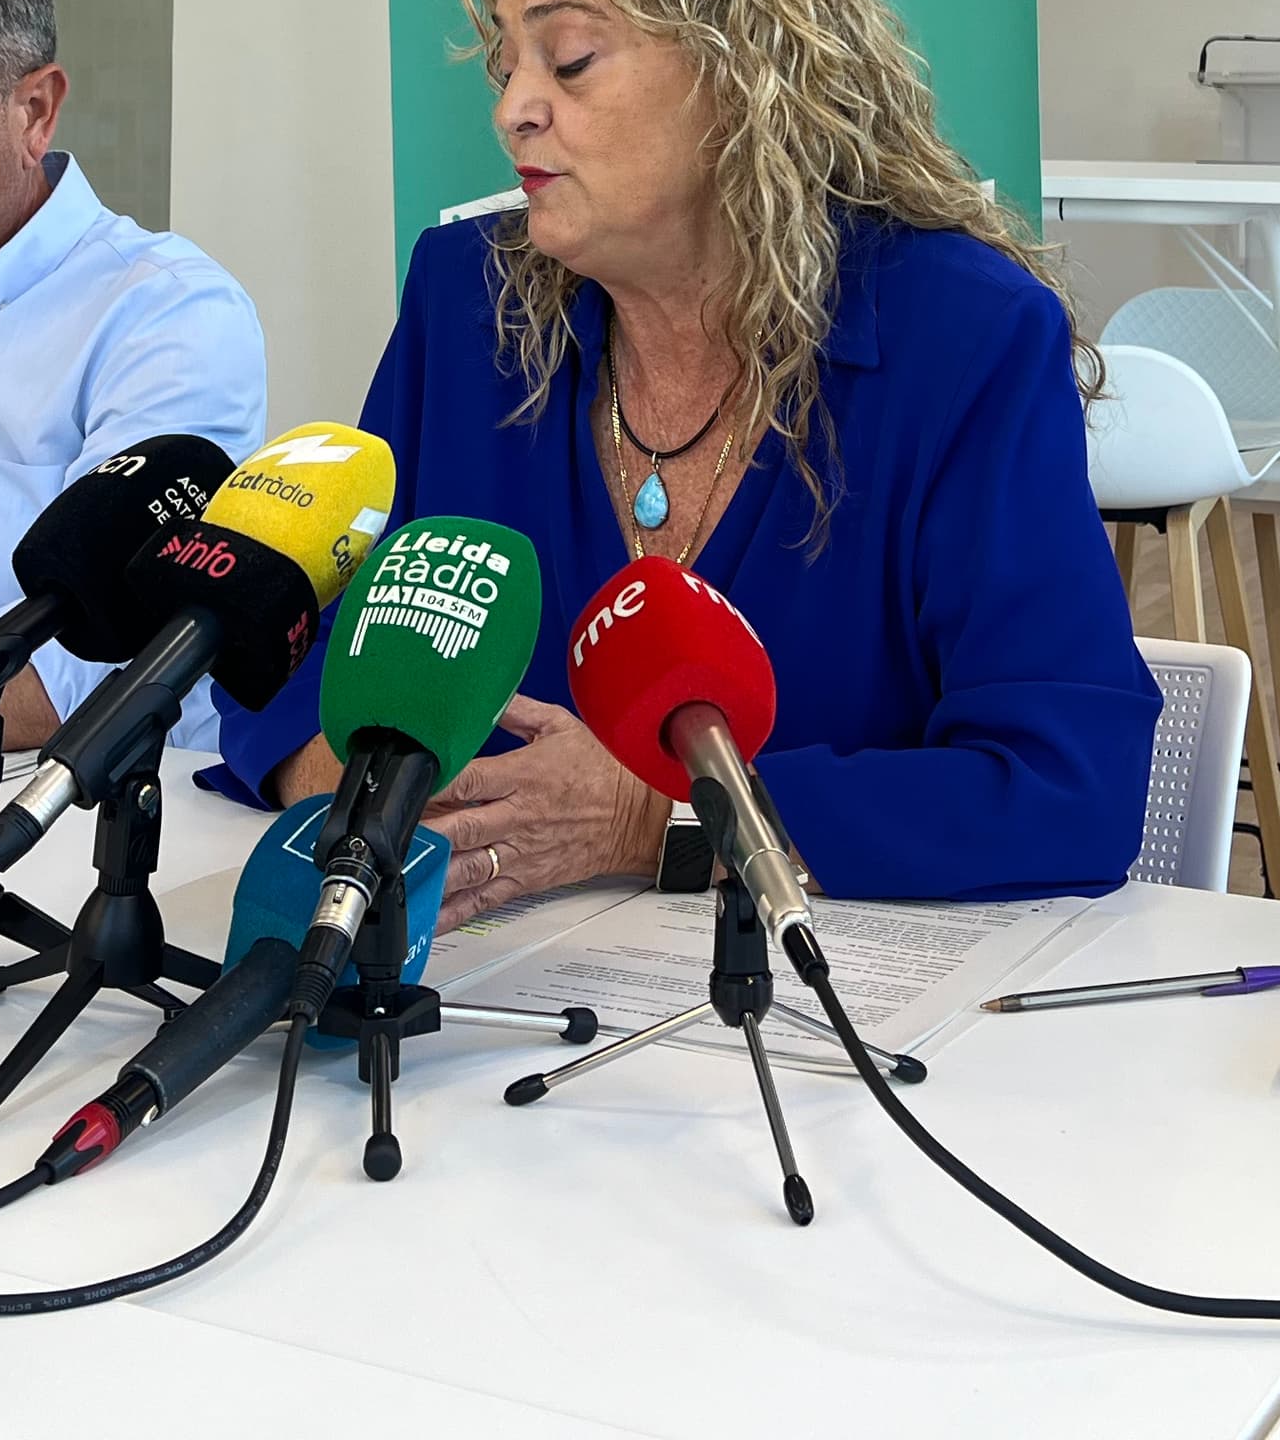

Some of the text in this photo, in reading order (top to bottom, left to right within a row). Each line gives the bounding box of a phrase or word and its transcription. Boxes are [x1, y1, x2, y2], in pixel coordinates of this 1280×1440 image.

[87, 455, 147, 478] cn
[228, 470, 314, 508] Catràdio
[148, 499, 172, 526] DE
[389, 531, 511, 577] Lleida
[366, 585, 415, 605] UA1
[373, 553, 498, 604] Ràdio
[573, 580, 647, 668] rne
